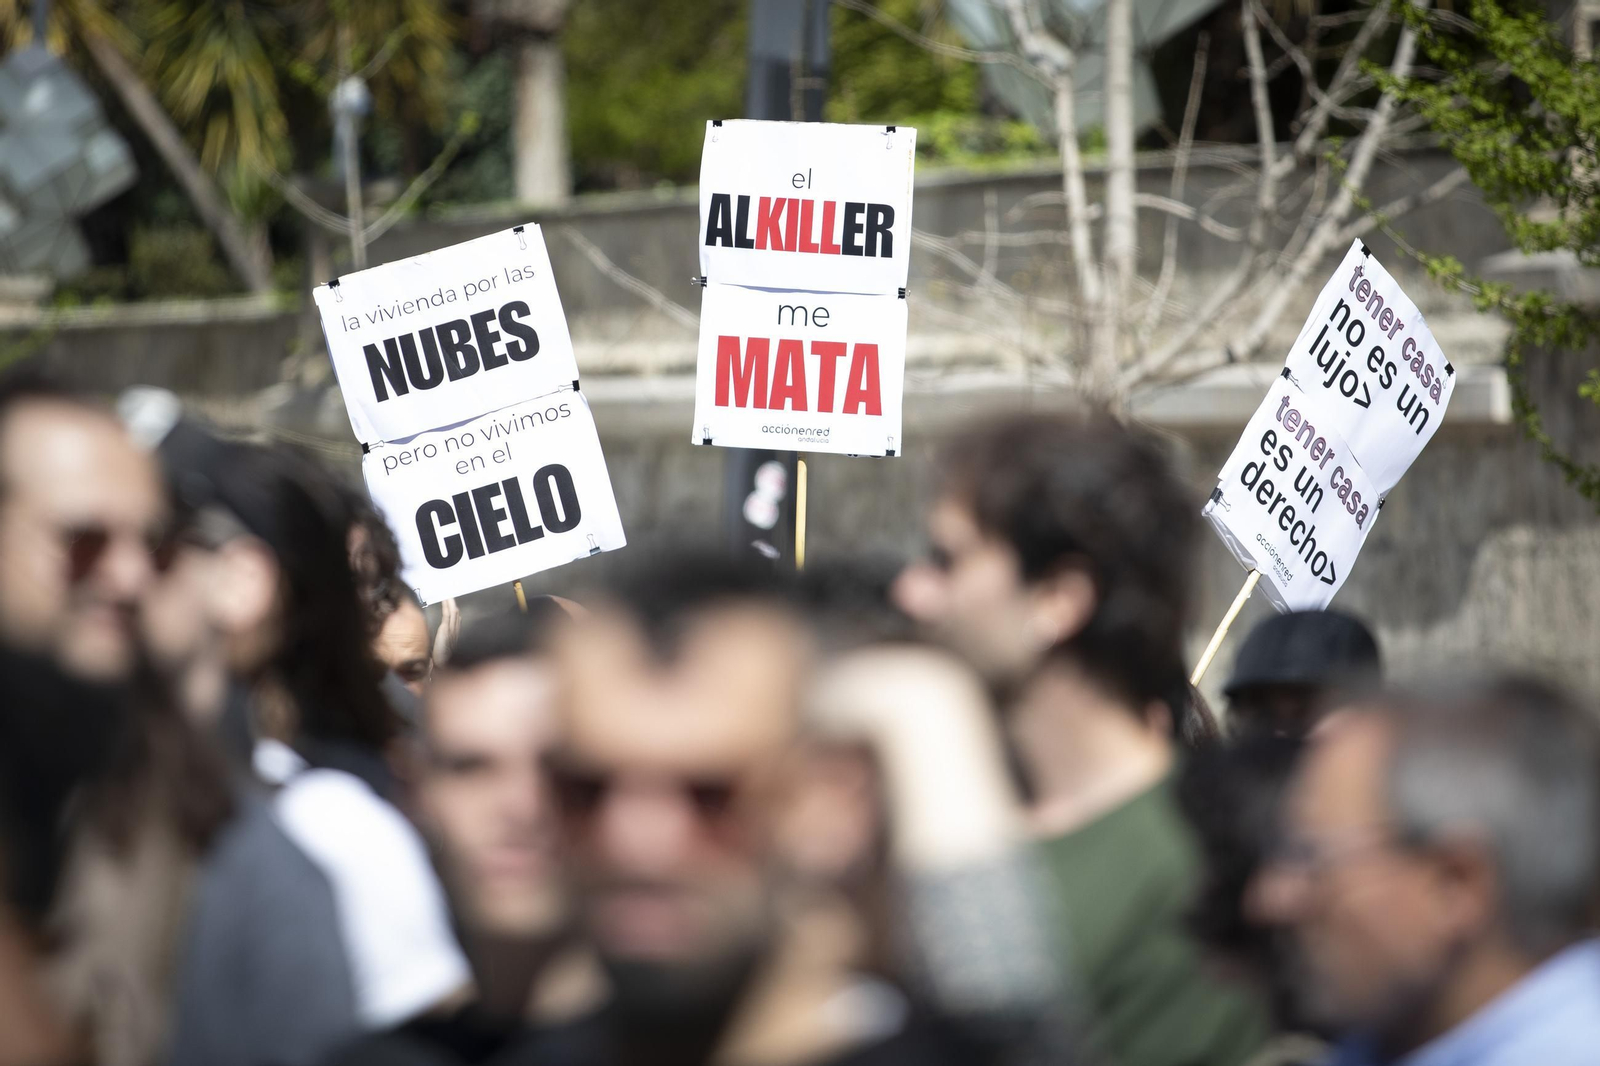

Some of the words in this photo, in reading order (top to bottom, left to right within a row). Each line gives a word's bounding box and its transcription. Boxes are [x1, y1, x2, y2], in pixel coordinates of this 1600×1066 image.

[791, 168, 812, 190] el
[704, 192, 895, 258] ALKILLER
[341, 315, 361, 332] la
[365, 287, 457, 325] vivienda
[463, 275, 498, 303] por
[504, 263, 536, 285] las
[777, 304, 830, 328] me
[1348, 265, 1405, 341] tener
[1401, 336, 1443, 405] casa
[362, 300, 540, 403] NUBES
[714, 335, 883, 416] MATA
[1329, 297, 1366, 348] no
[1366, 345, 1397, 390] es
[1396, 384, 1431, 435] un
[382, 441, 438, 476] pero
[444, 432, 475, 453] no
[480, 402, 572, 442] vivimos
[455, 457, 486, 475] en
[491, 443, 512, 464] el
[1260, 429, 1293, 472] es
[1293, 465, 1325, 514] un
[1275, 394, 1335, 470] tener
[1329, 465, 1369, 530] casa
[414, 463, 582, 570] CIELO
